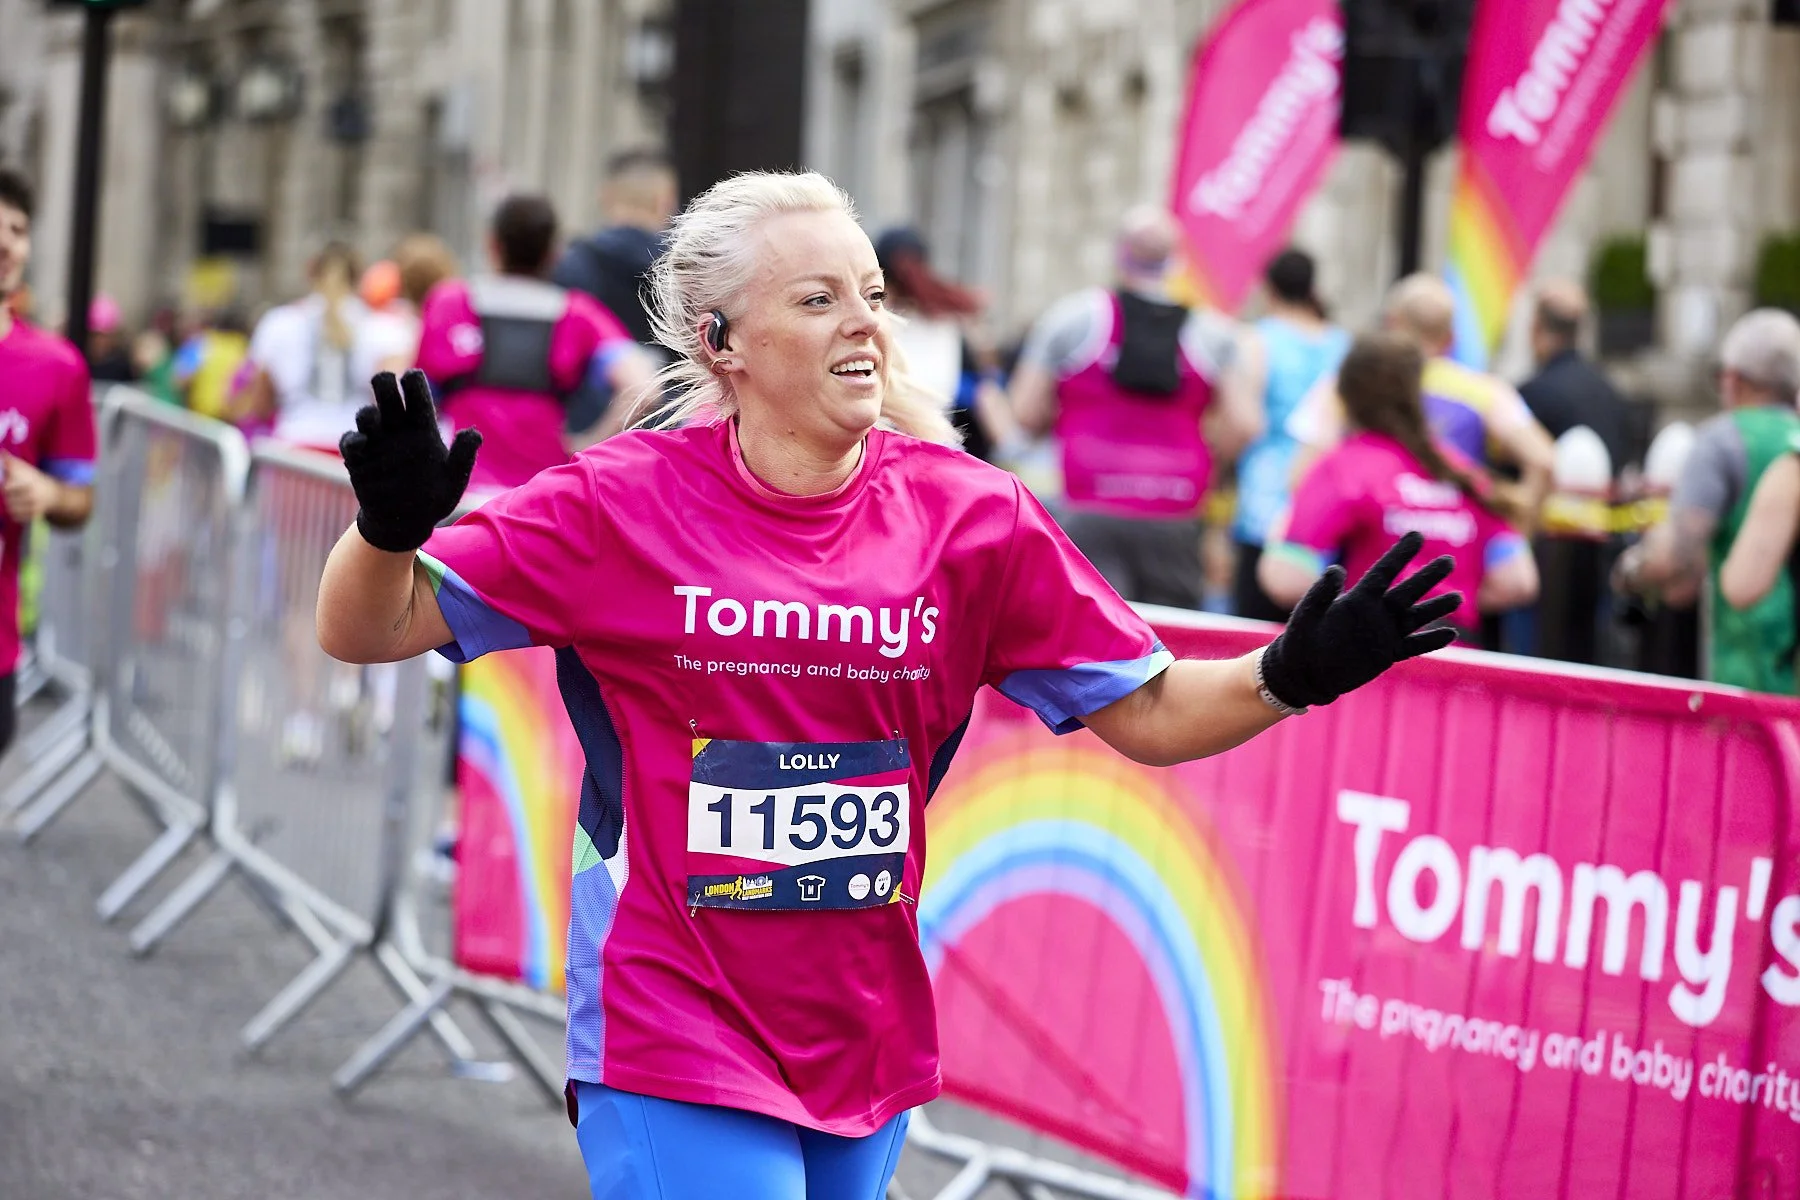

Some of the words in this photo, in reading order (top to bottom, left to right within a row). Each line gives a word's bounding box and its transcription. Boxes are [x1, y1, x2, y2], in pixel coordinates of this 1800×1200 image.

[674, 585, 939, 658] Tommy's
[674, 655, 702, 670] The
[707, 658, 801, 678] pregnancy
[807, 663, 841, 678] and
[847, 664, 889, 683] baby
[779, 753, 840, 770] LOLLY
[707, 791, 900, 851] 11593
[704, 883, 735, 896] LONDON
[879, 883, 885, 892] 4
[1336, 789, 1800, 1027] Tommy's
[1318, 977, 1379, 1031] The
[1543, 1031, 1606, 1075] and
[1610, 1032, 1694, 1101] baby
